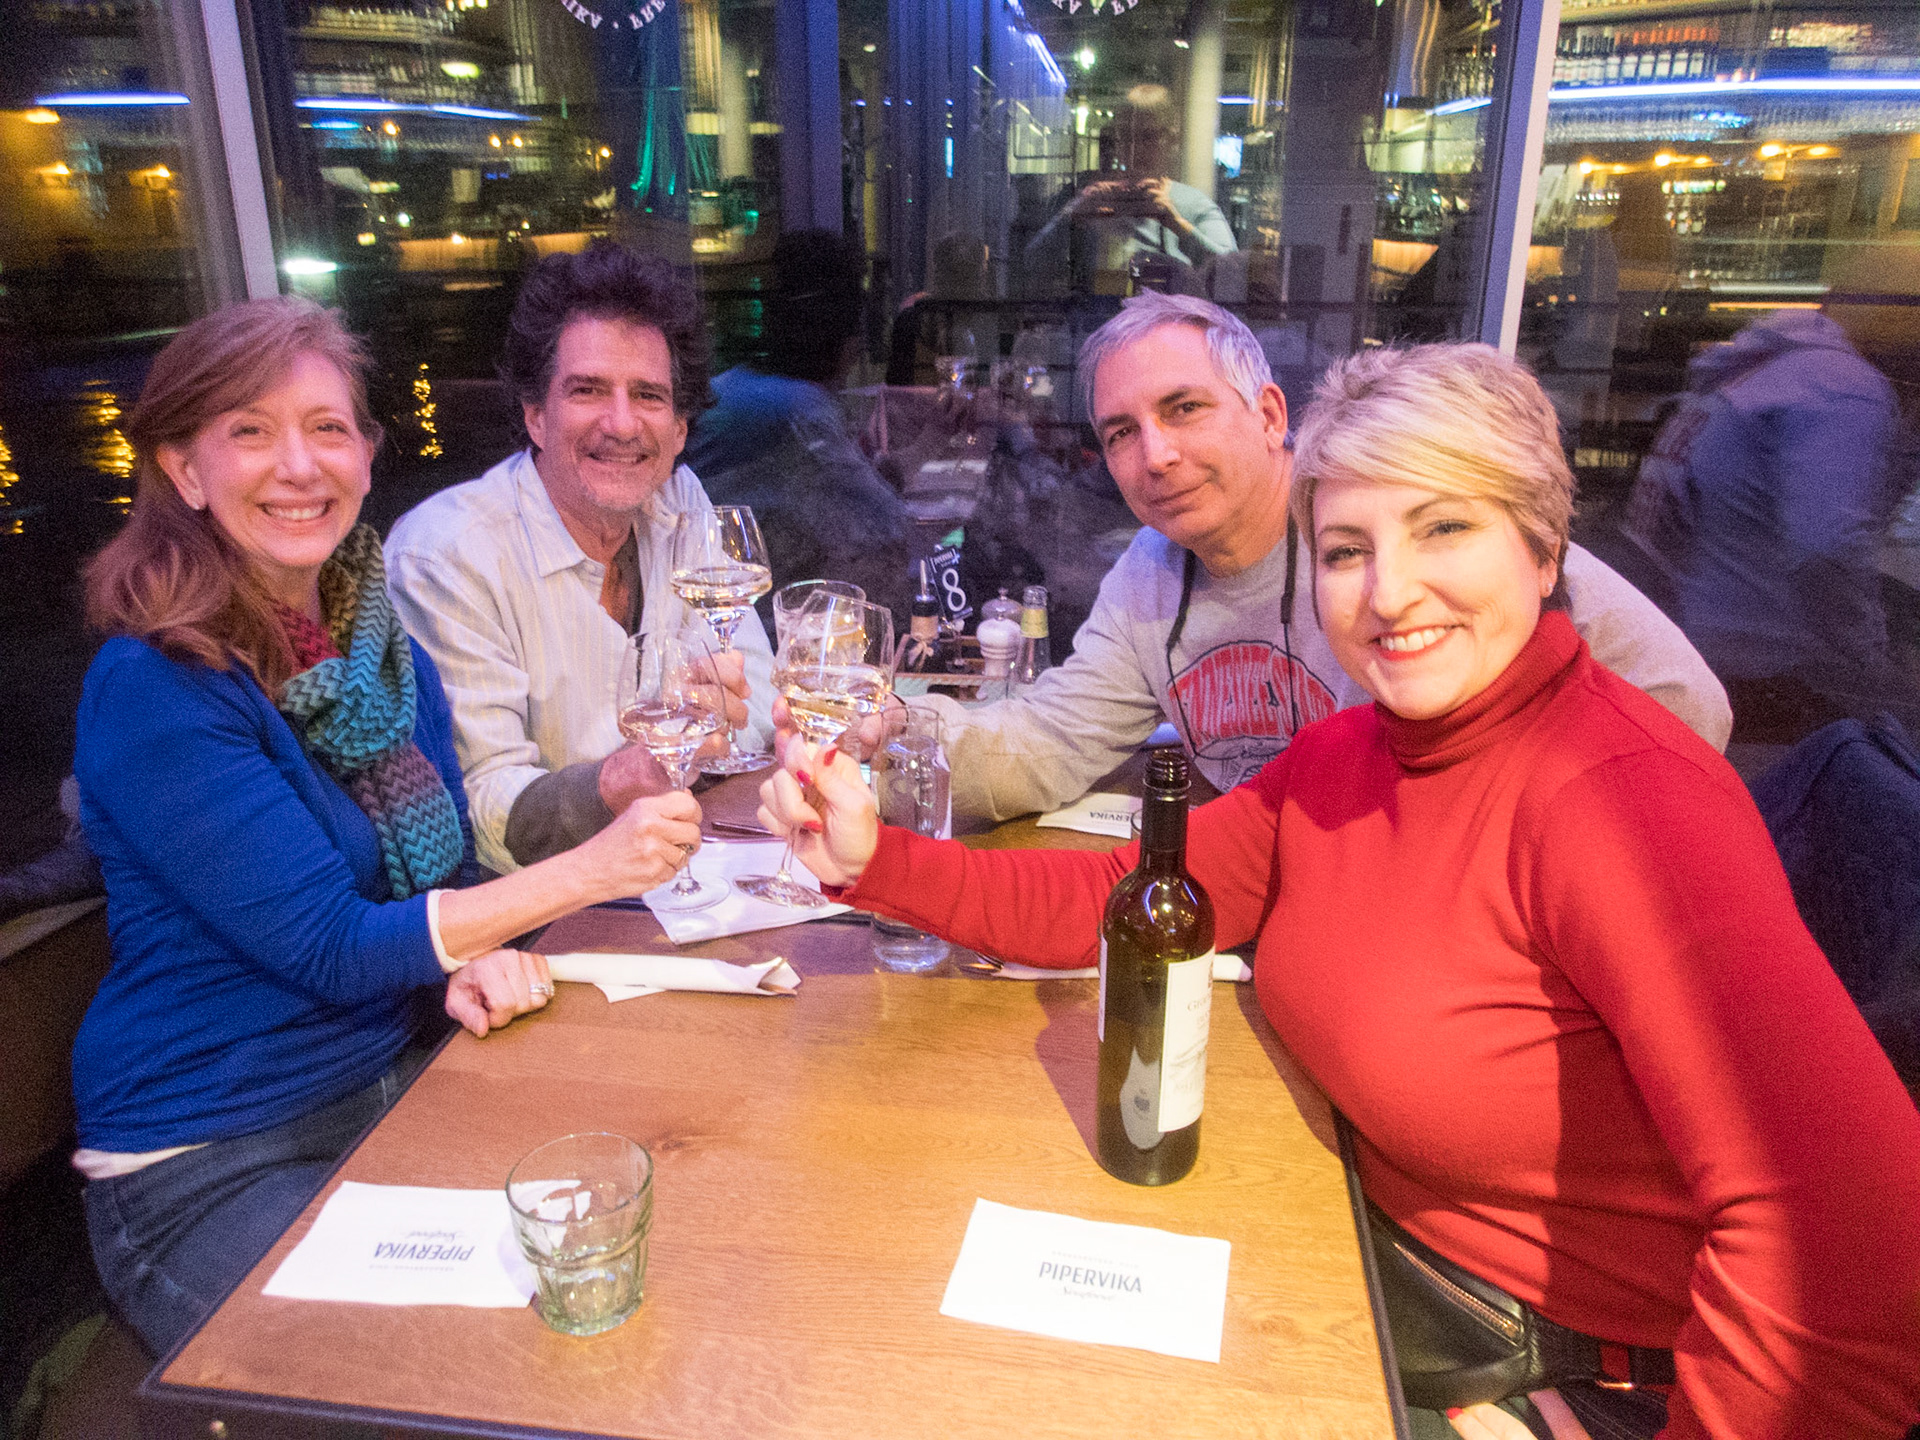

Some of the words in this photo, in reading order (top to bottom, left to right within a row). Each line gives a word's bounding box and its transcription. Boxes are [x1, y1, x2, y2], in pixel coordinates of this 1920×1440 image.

[942, 568, 966, 612] 8
[374, 1242, 475, 1262] PIPERVIKA
[1039, 1261, 1142, 1293] PIPERVIKA
